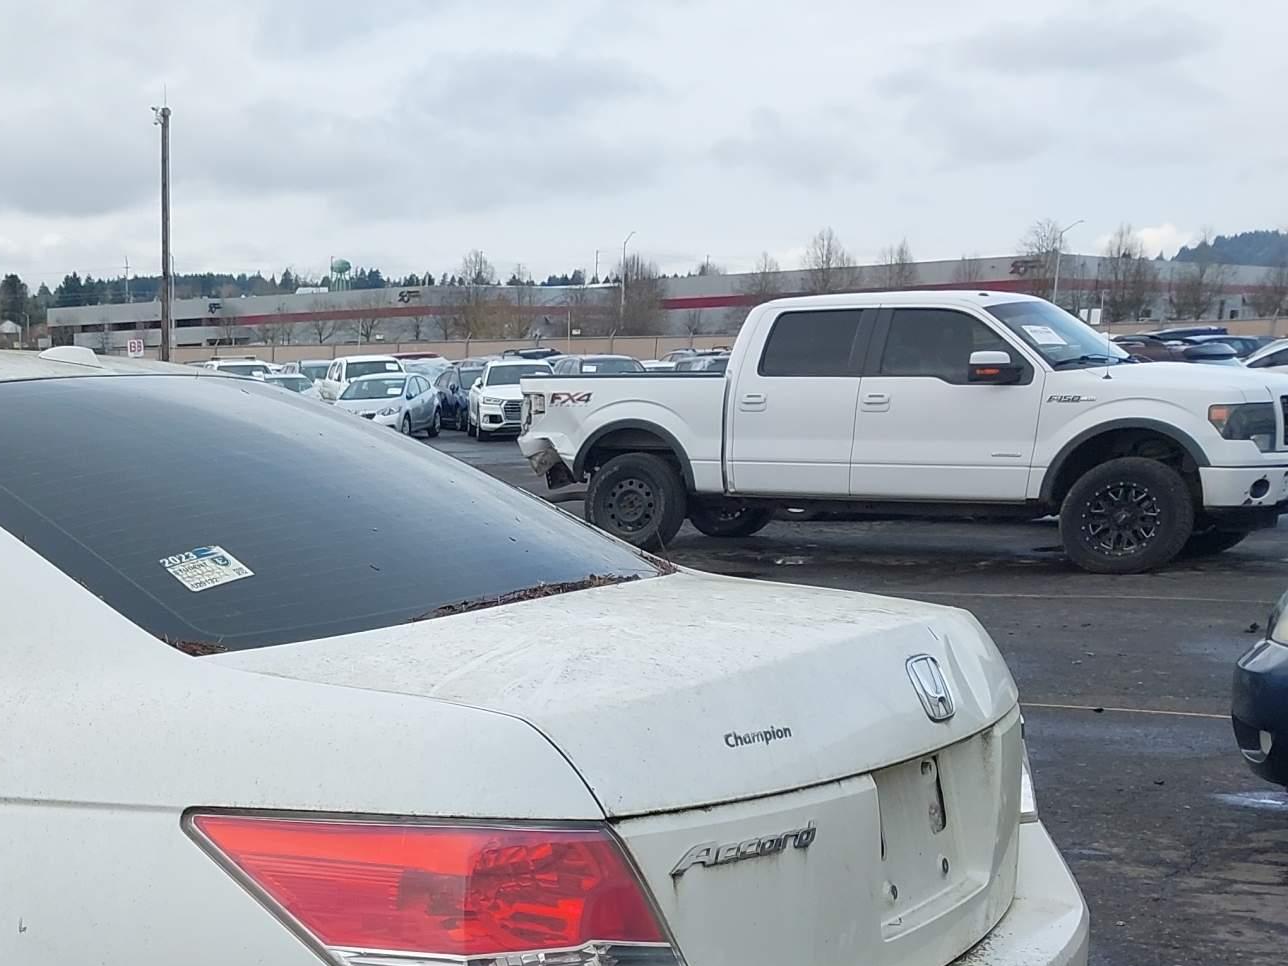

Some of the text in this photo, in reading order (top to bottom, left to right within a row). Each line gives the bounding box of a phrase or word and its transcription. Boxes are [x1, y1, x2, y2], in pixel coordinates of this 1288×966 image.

[551, 392, 592, 404] FX4
[159, 551, 197, 568] 2023
[724, 725, 792, 748] Champion
[669, 820, 817, 877] Accord
